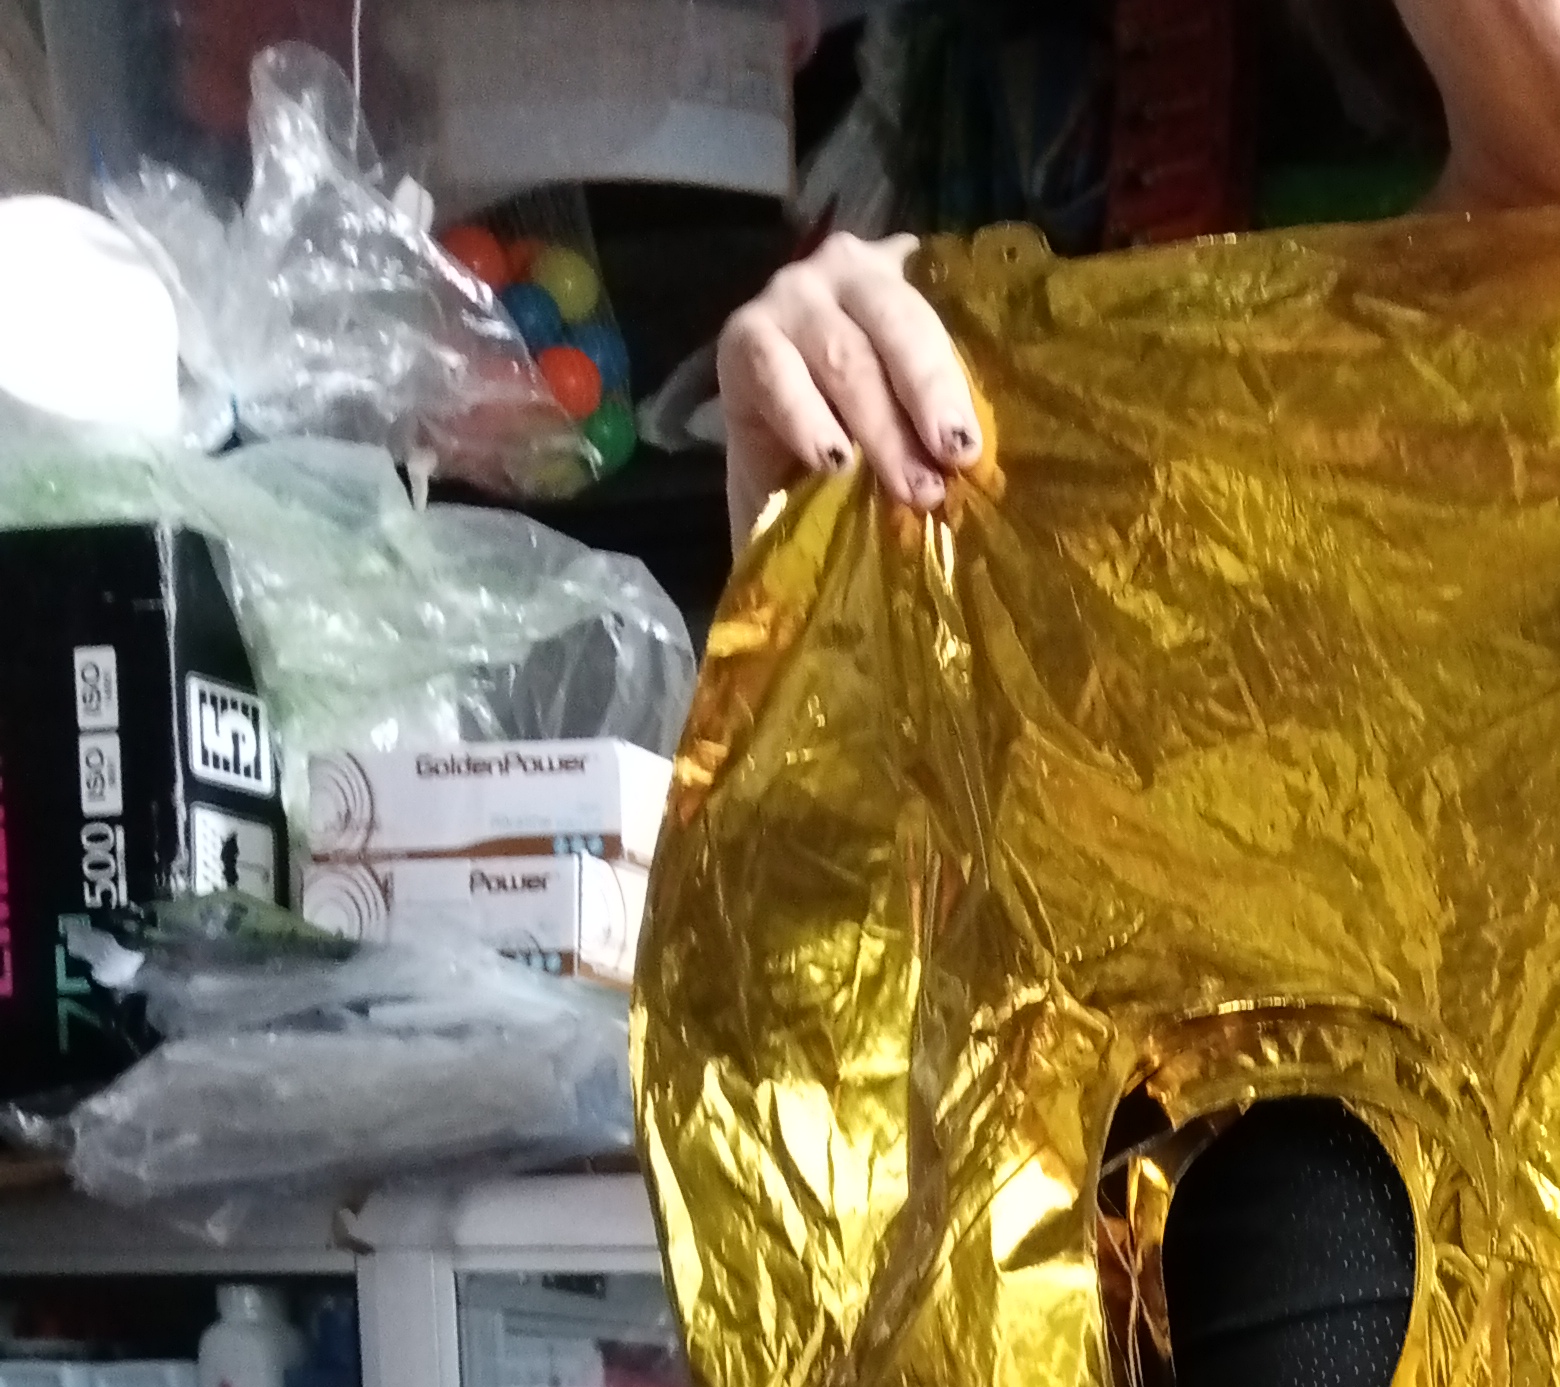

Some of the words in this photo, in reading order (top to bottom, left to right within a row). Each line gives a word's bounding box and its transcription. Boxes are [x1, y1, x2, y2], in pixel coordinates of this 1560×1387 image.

[415, 751, 588, 776] GoldenPower
[80, 821, 118, 909] 500
[469, 871, 551, 896] Power
